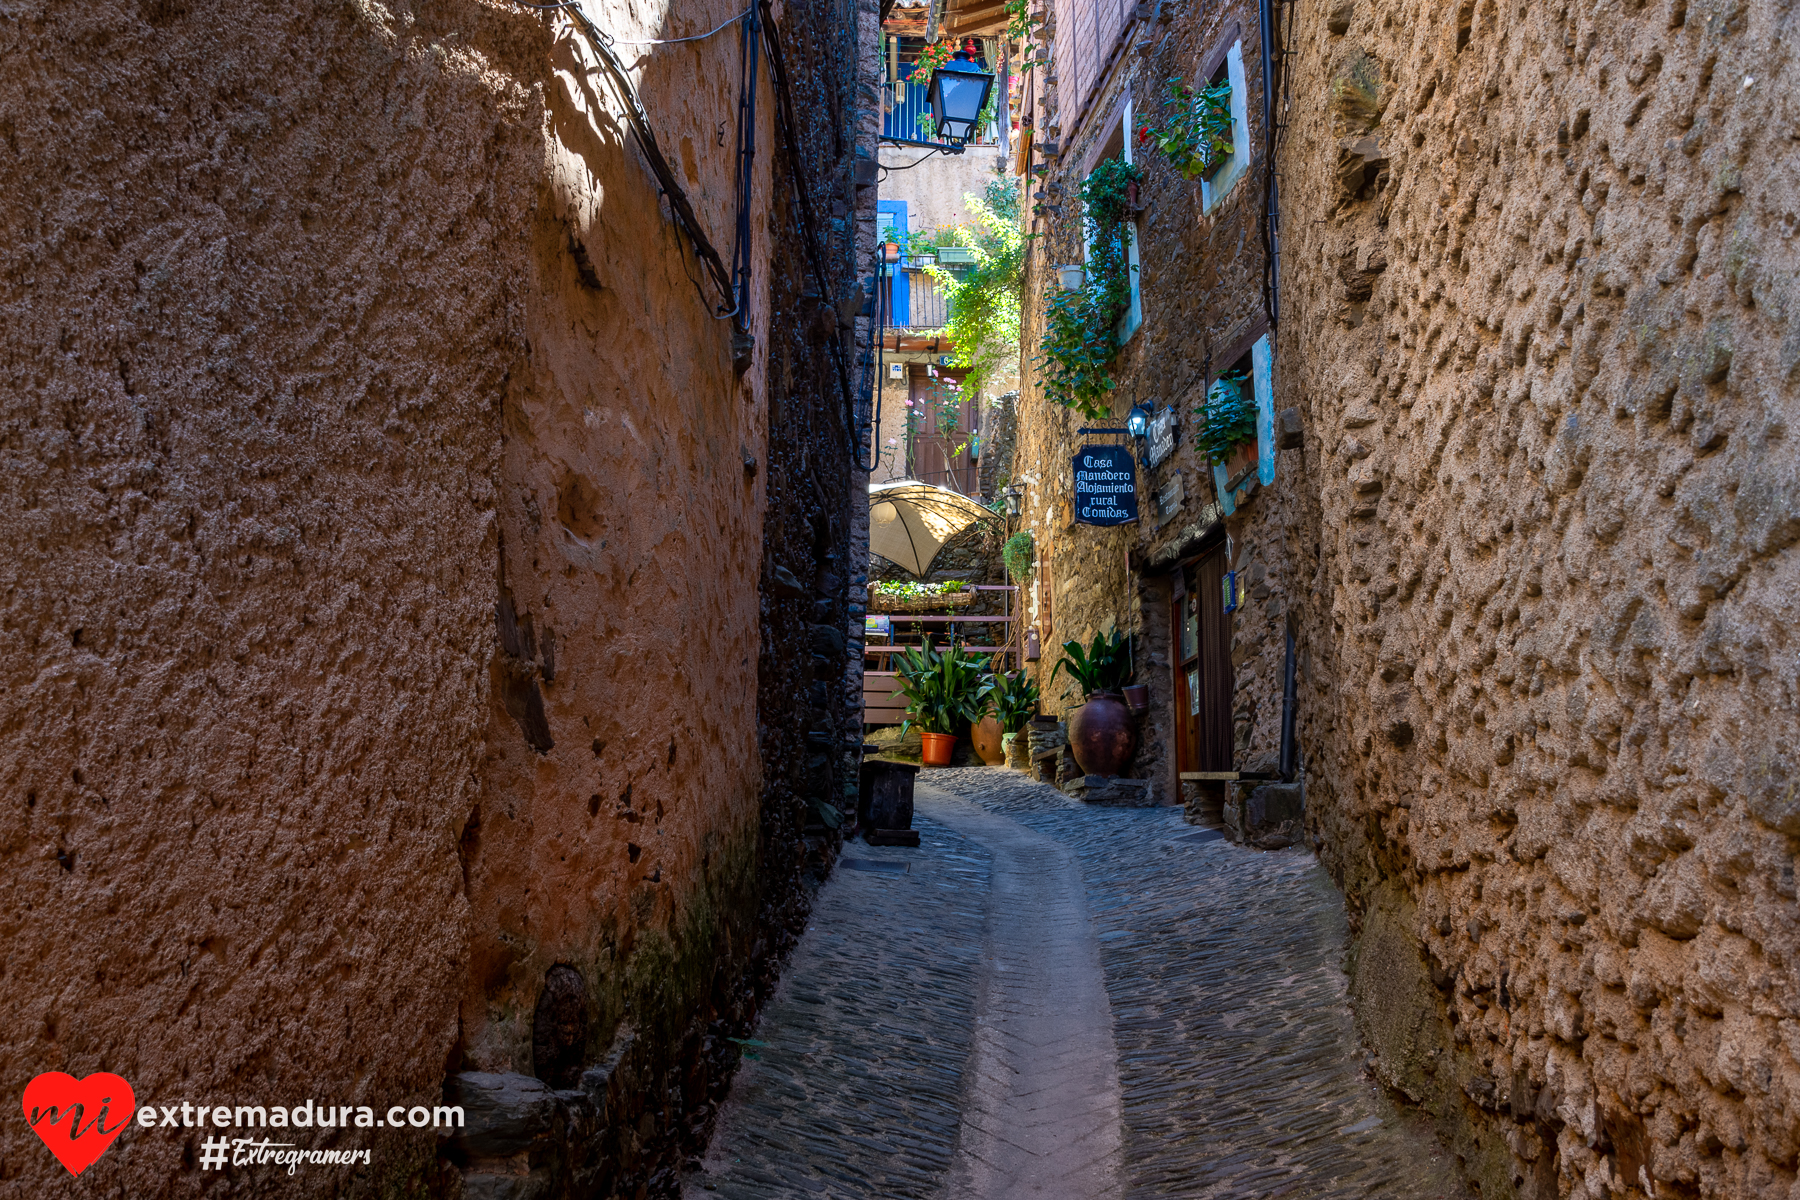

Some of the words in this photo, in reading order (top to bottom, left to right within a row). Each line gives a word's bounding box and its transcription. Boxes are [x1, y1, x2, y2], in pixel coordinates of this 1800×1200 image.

[1083, 455, 1113, 469] Casa
[1076, 470, 1131, 482] Manadero
[1076, 481, 1134, 494] Alojamiento
[1090, 495, 1118, 506] rural
[1082, 506, 1129, 518] Comidas
